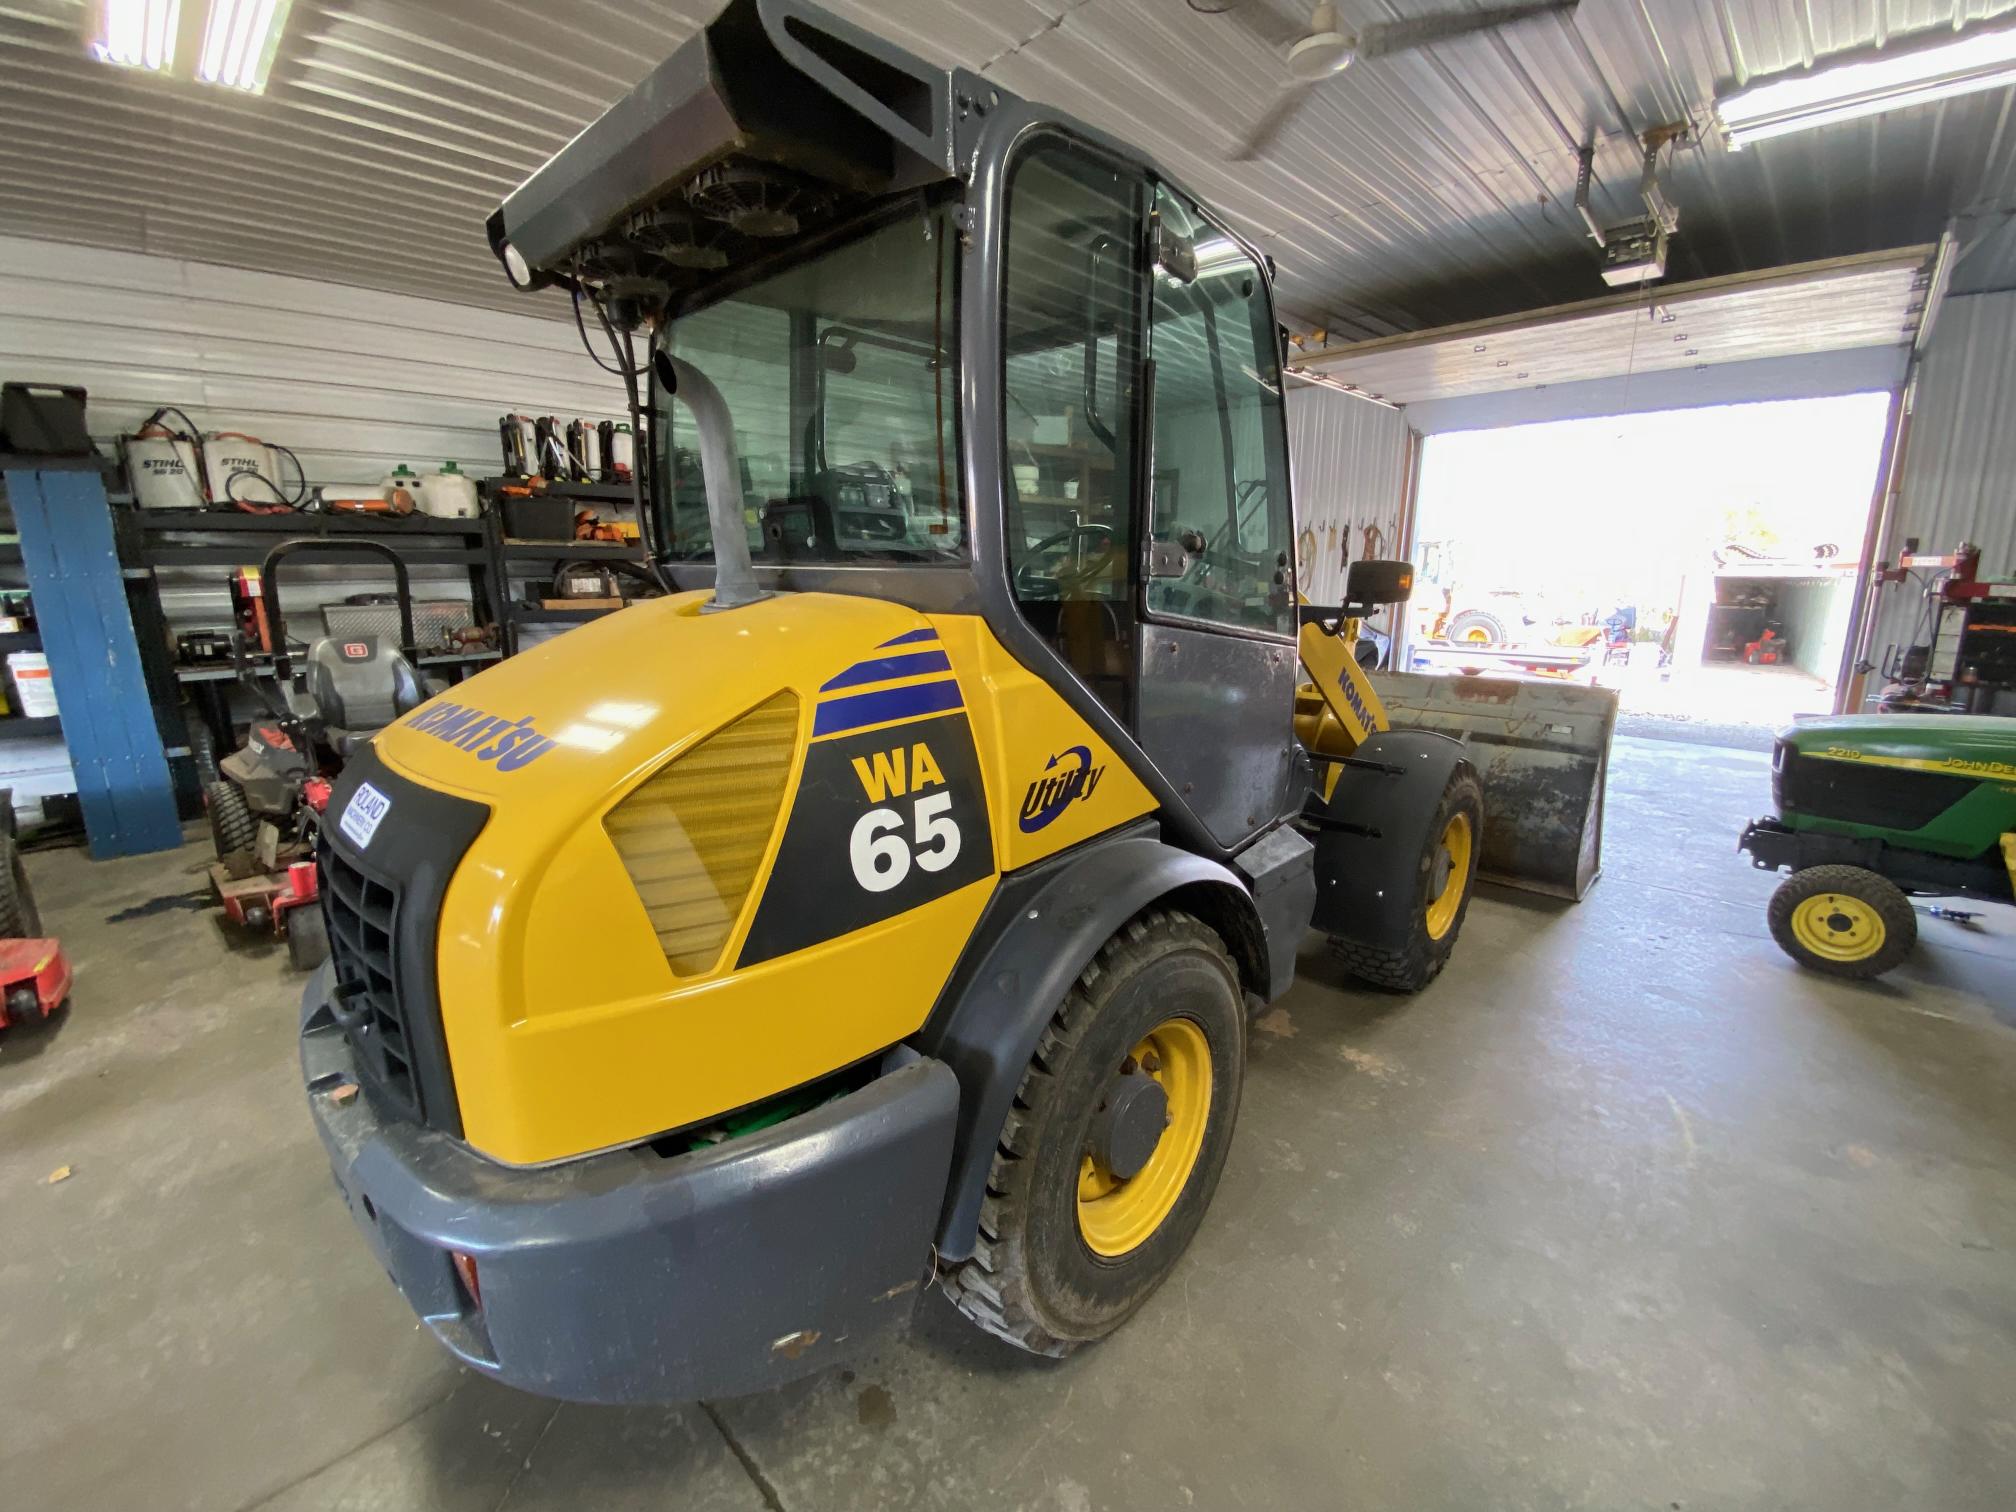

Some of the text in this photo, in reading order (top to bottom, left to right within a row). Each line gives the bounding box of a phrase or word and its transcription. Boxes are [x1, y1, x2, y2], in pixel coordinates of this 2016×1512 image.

[143, 459, 184, 469] STIHL
[220, 457, 259, 467] STIHL
[1338, 666, 1377, 737] KOMATS
[403, 701, 558, 772] KOMATSU
[1827, 747, 1861, 760] 2210
[851, 742, 946, 804] WA
[1023, 765, 1106, 817] Utility
[354, 786, 385, 820] ROLAND
[849, 790, 961, 893] 65
